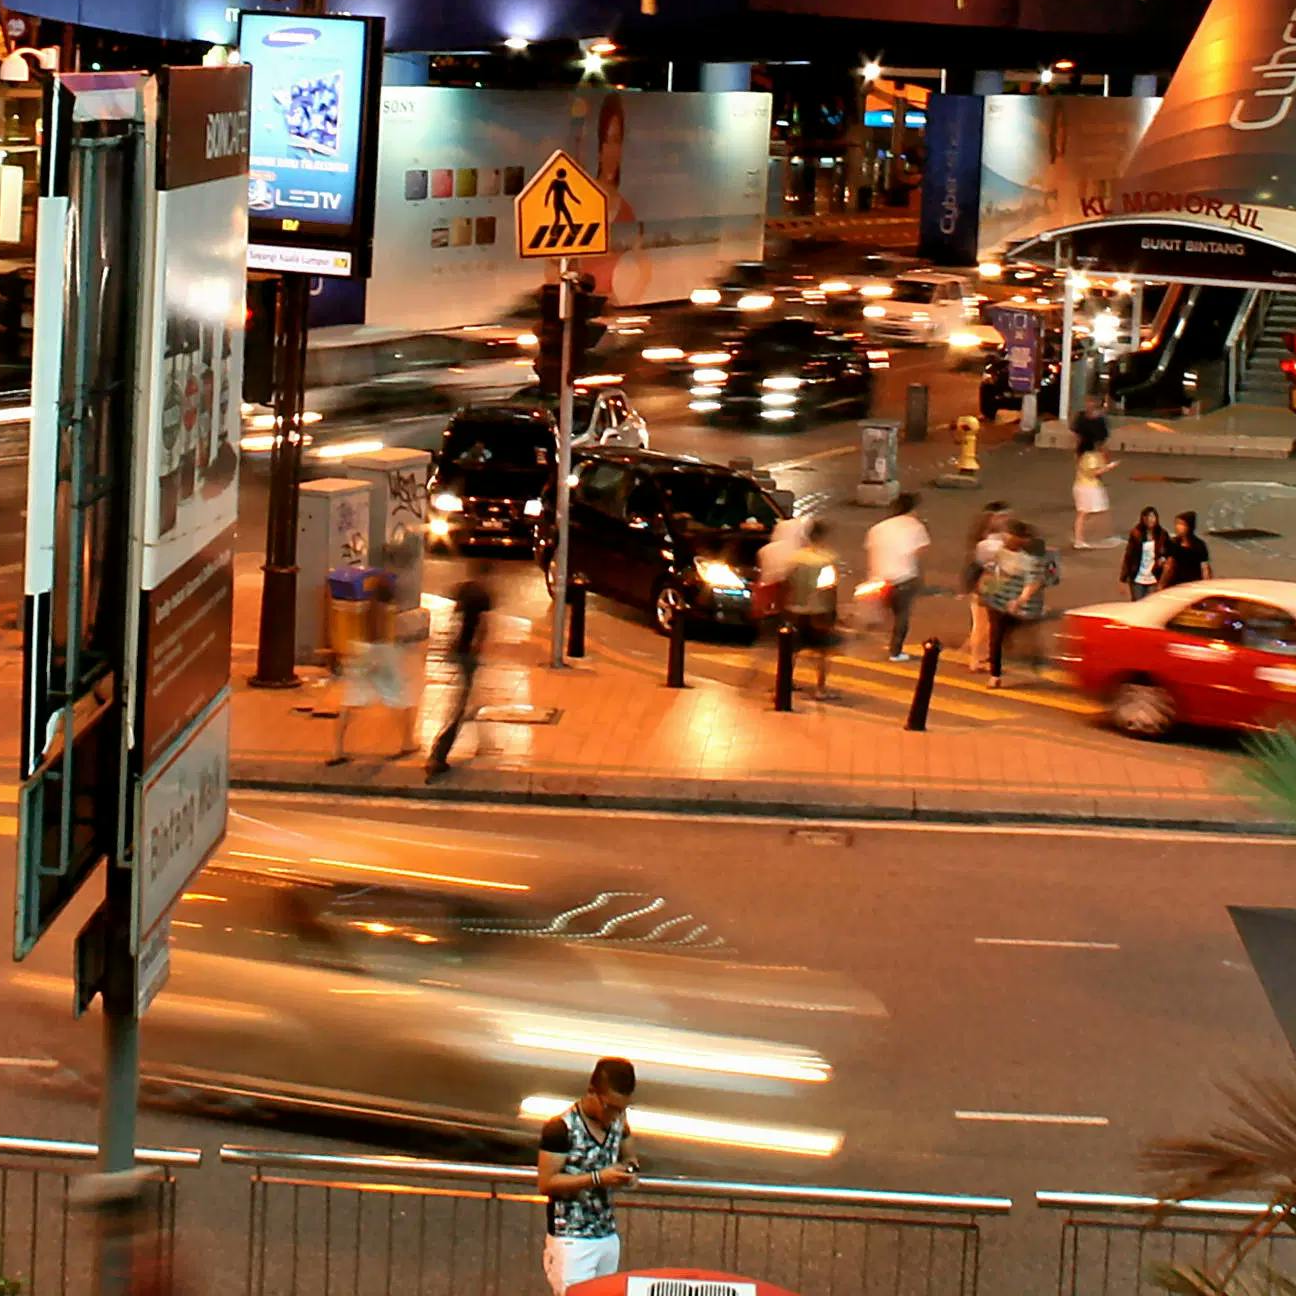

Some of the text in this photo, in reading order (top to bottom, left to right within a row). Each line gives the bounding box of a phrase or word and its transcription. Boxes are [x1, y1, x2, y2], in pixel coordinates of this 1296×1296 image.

[1122, 189, 1265, 231] MONORAIL
[1141, 236, 1246, 256] BUKIT BINTANG
